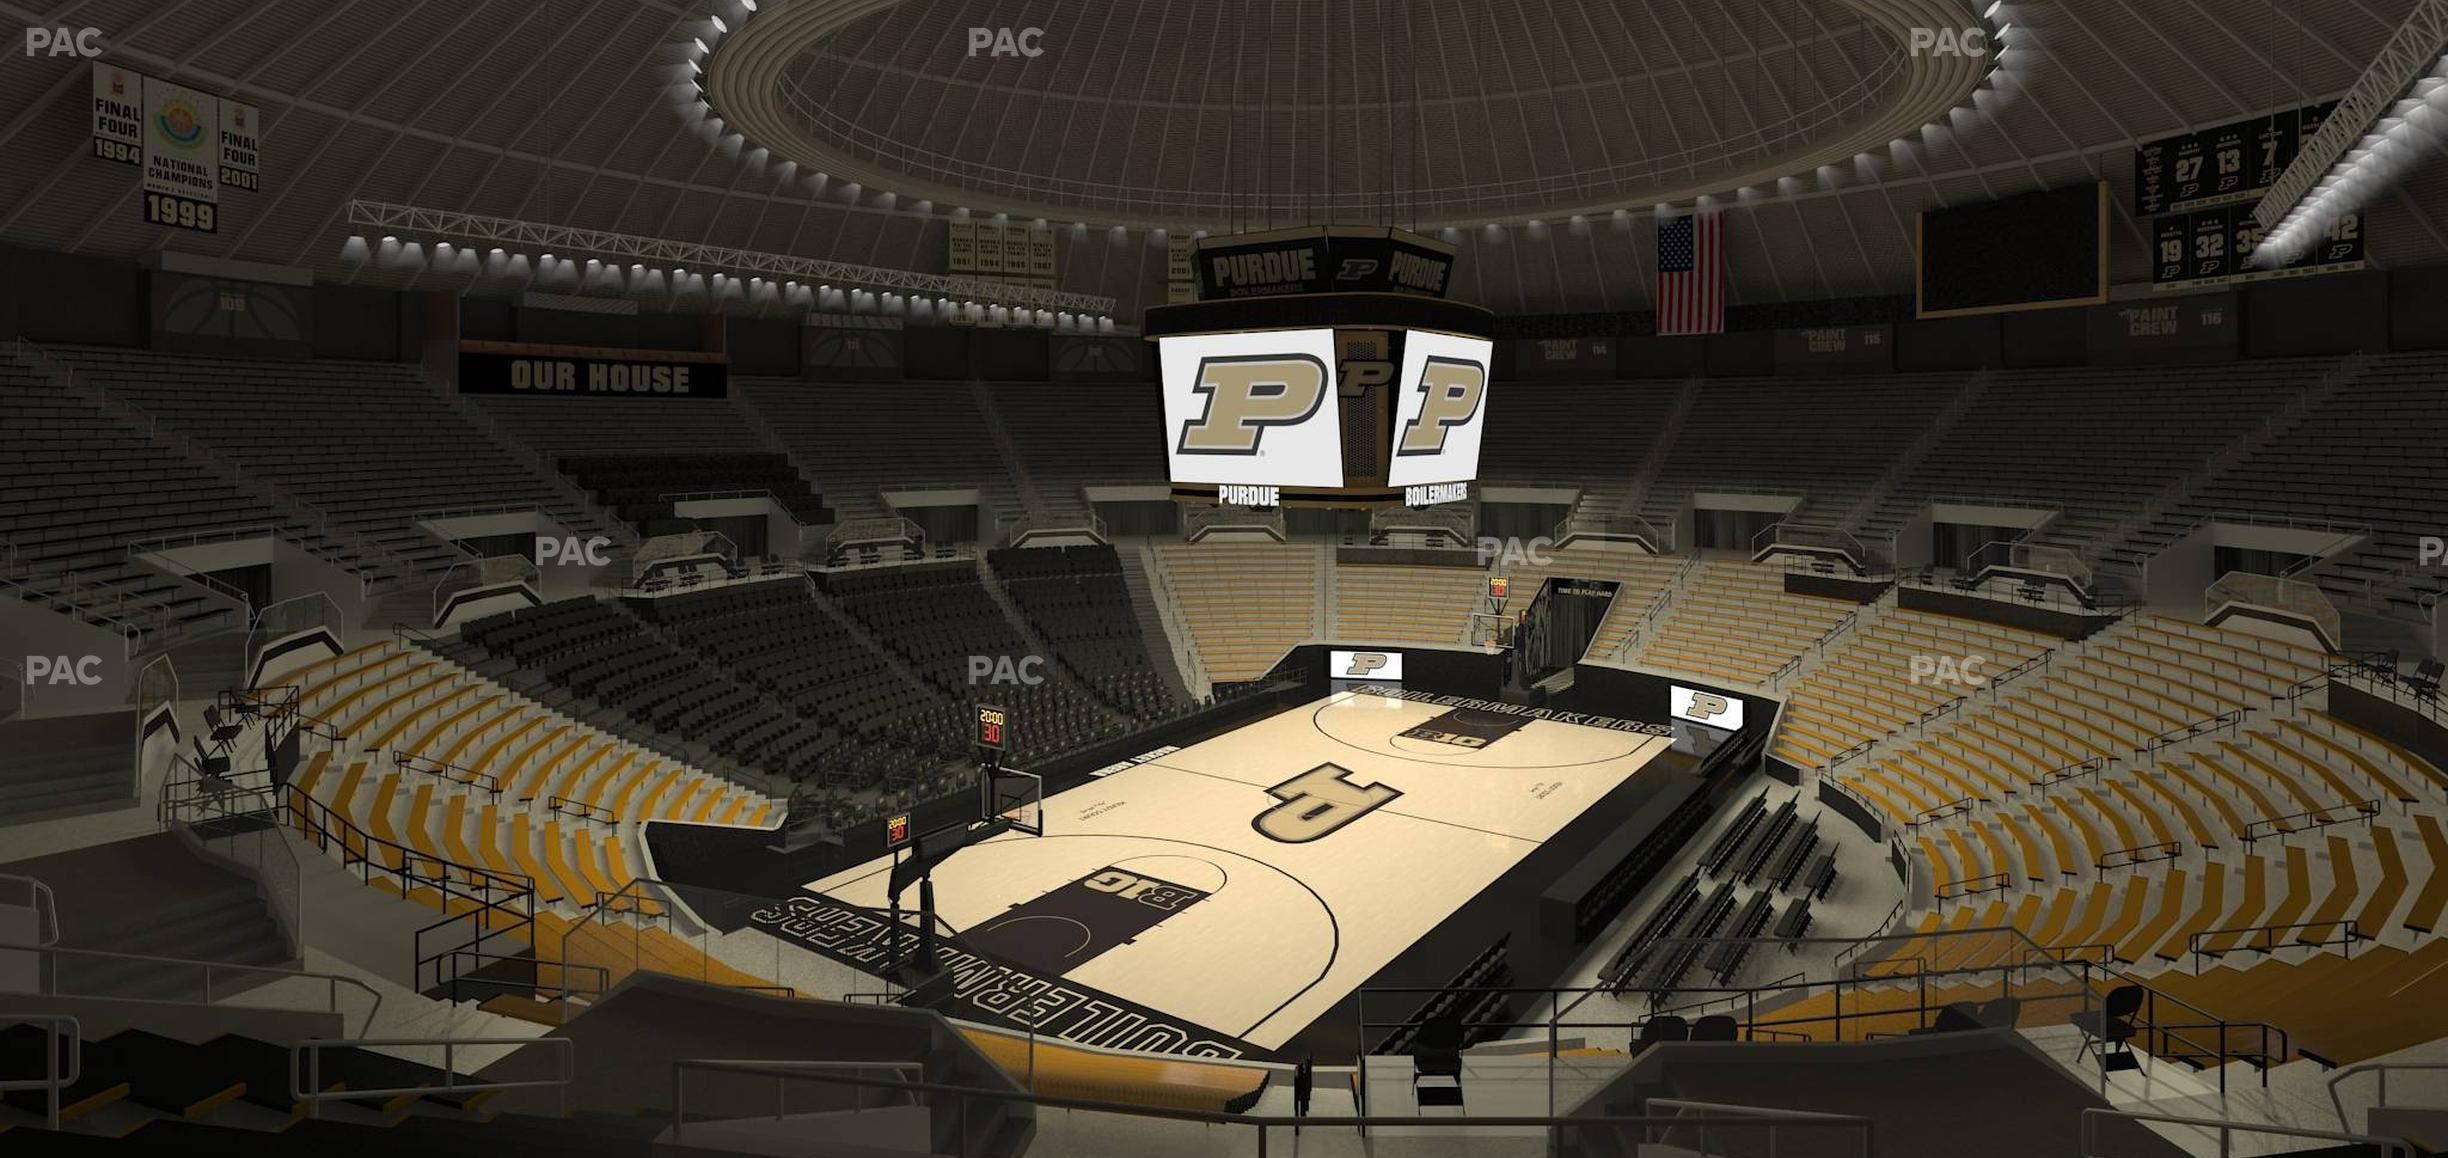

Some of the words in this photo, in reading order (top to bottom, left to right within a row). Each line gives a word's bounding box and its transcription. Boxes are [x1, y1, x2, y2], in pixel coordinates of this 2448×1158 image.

[96, 98, 140, 121] FINAL
[99, 116, 137, 138] FOUR
[95, 138, 141, 166] 1994
[222, 131, 258, 151] FINAL
[224, 148, 255, 166] FOUR
[2217, 149, 2240, 175] 13
[2261, 140, 2278, 167] 7
[149, 167, 213, 190] CHAMPIONS
[153, 156, 208, 177] NATIONAL
[2175, 156, 2203, 184] 27
[220, 167, 258, 191] 2001
[147, 194, 214, 230] 1999
[2161, 239, 2182, 263] 19
[2196, 233, 2224, 259] 32
[1213, 248, 1316, 287] PURDUE
[1388, 250, 1447, 292] PURDUE
[2127, 305, 2178, 322] PAINT
[2130, 320, 2177, 337] CREW
[511, 359, 576, 391] OUR
[588, 363, 690, 394] HOUSE
[1219, 485, 1280, 507] PURDUE
[1405, 482, 1468, 507] BOILERMAKERS
[980, 709, 1003, 725] 20:00
[1351, 684, 1674, 736] BOILERMAKERS
[983, 723, 1000, 743] 30
[890, 824, 905, 842] 30
